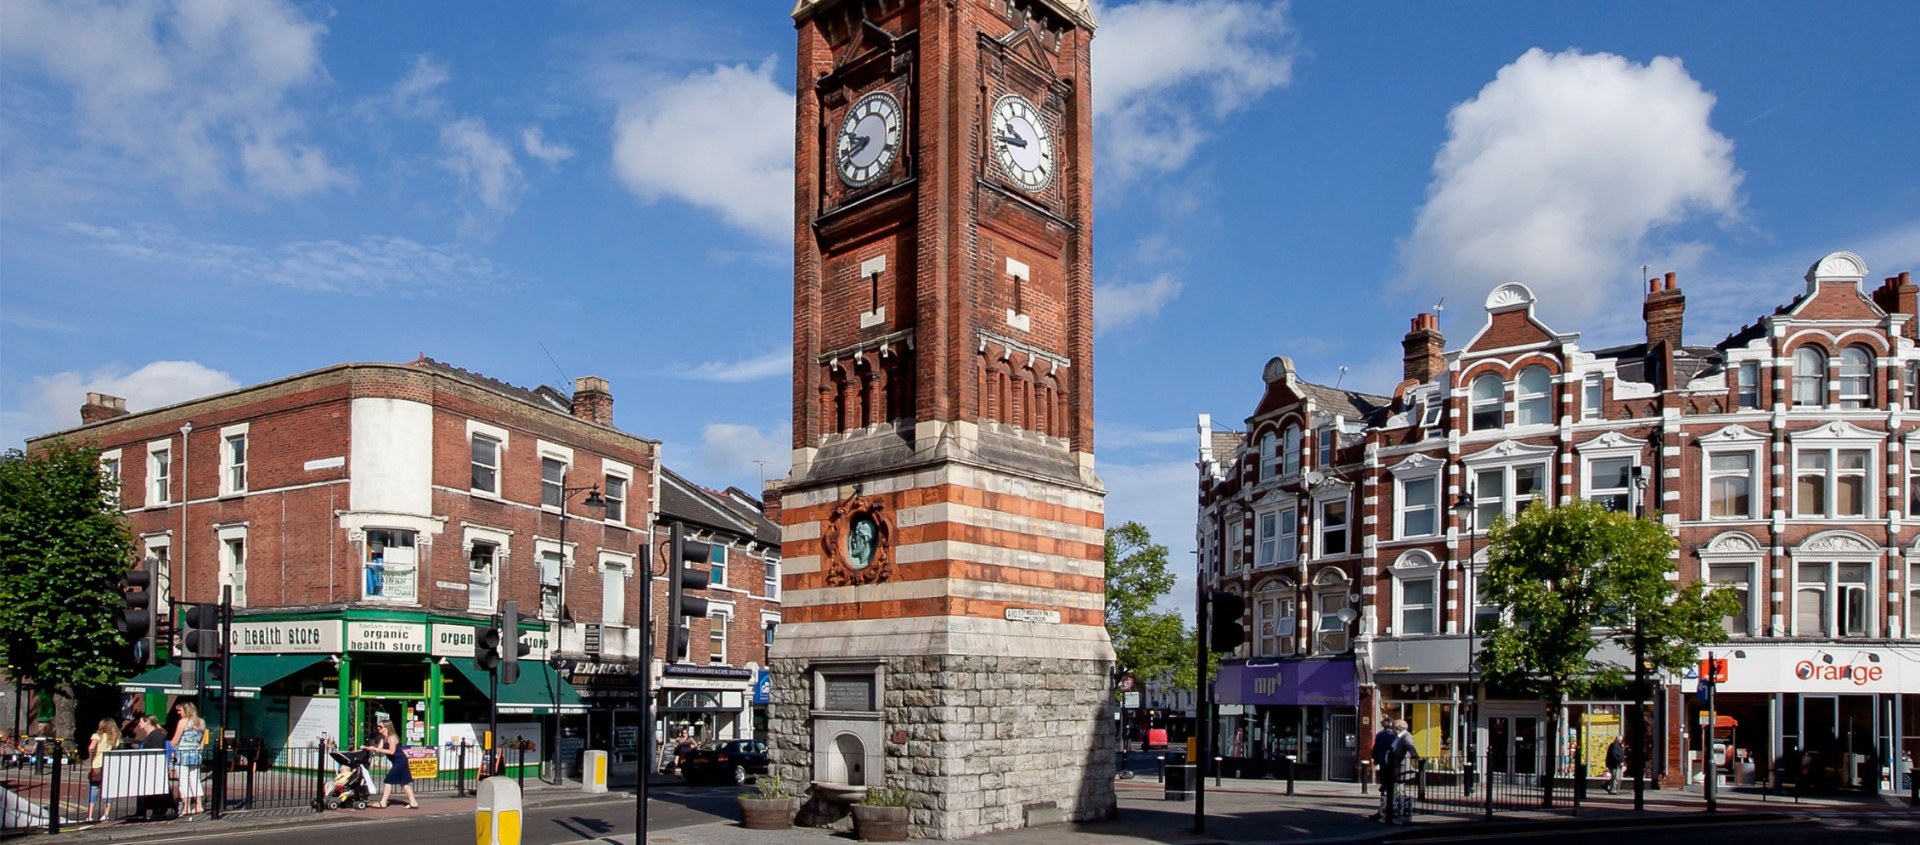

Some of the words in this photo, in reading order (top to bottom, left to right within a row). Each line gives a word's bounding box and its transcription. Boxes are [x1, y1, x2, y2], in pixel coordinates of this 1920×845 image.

[1008, 610, 1021, 619] A103
[245, 627, 282, 645] health
[288, 627, 320, 645] store
[363, 629, 409, 639] organic
[441, 632, 473, 645] organ
[351, 641, 386, 650] health
[392, 642, 423, 652] store
[523, 637, 549, 649] store
[573, 662, 629, 676] EXPRESS
[1795, 660, 1883, 686] Orange
[572, 676, 590, 684] DRY
[1254, 672, 1282, 696] mp4
